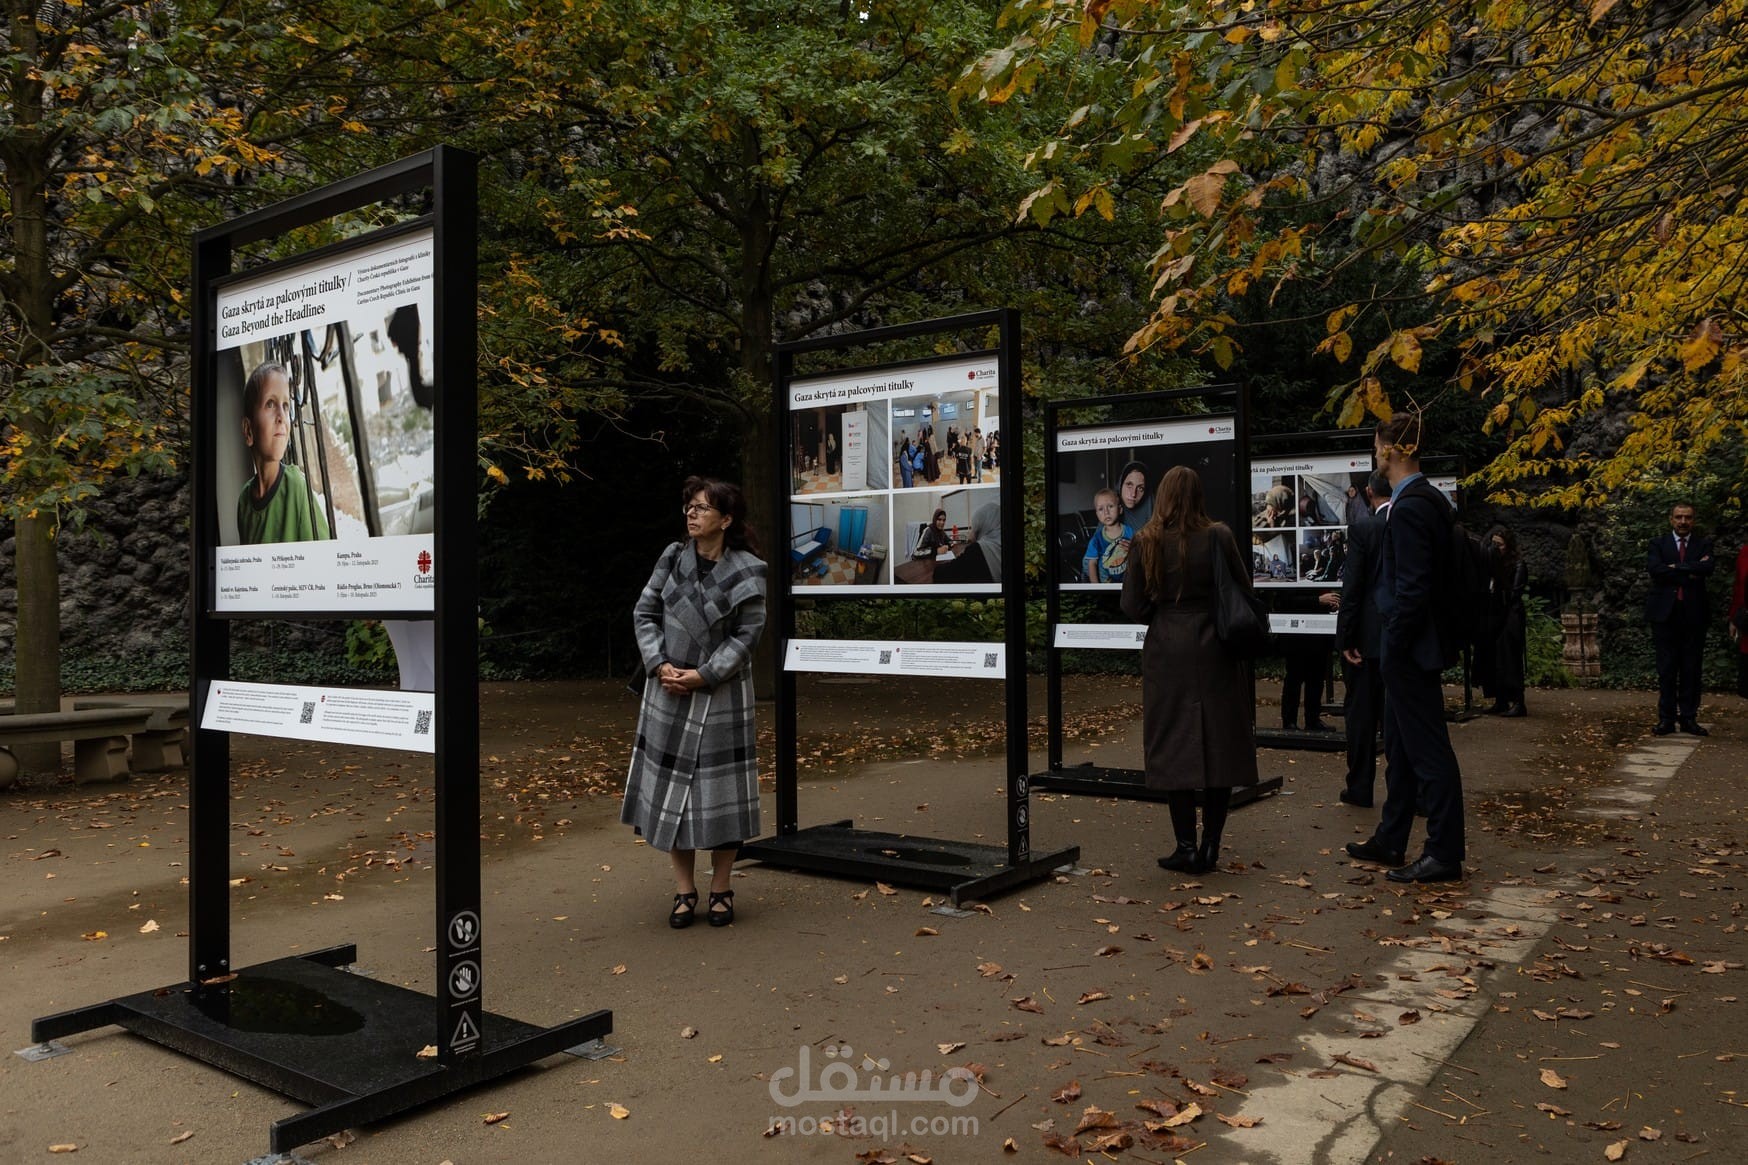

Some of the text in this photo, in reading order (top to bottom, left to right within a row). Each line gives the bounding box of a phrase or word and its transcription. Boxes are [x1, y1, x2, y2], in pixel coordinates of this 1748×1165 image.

[222, 271, 352, 319] Gaza skrytá za palcovými titulky /
[221, 303, 326, 338] Gaza Beyond the Headlines
[976, 368, 996, 377] Charita
[794, 379, 915, 402] Gaza skrytá za palcovými titulky
[1061, 439, 1078, 447] Gaza
[1078, 436, 1098, 447] skrytá
[1107, 432, 1141, 444] palcovými
[1142, 431, 1165, 441] titulky
